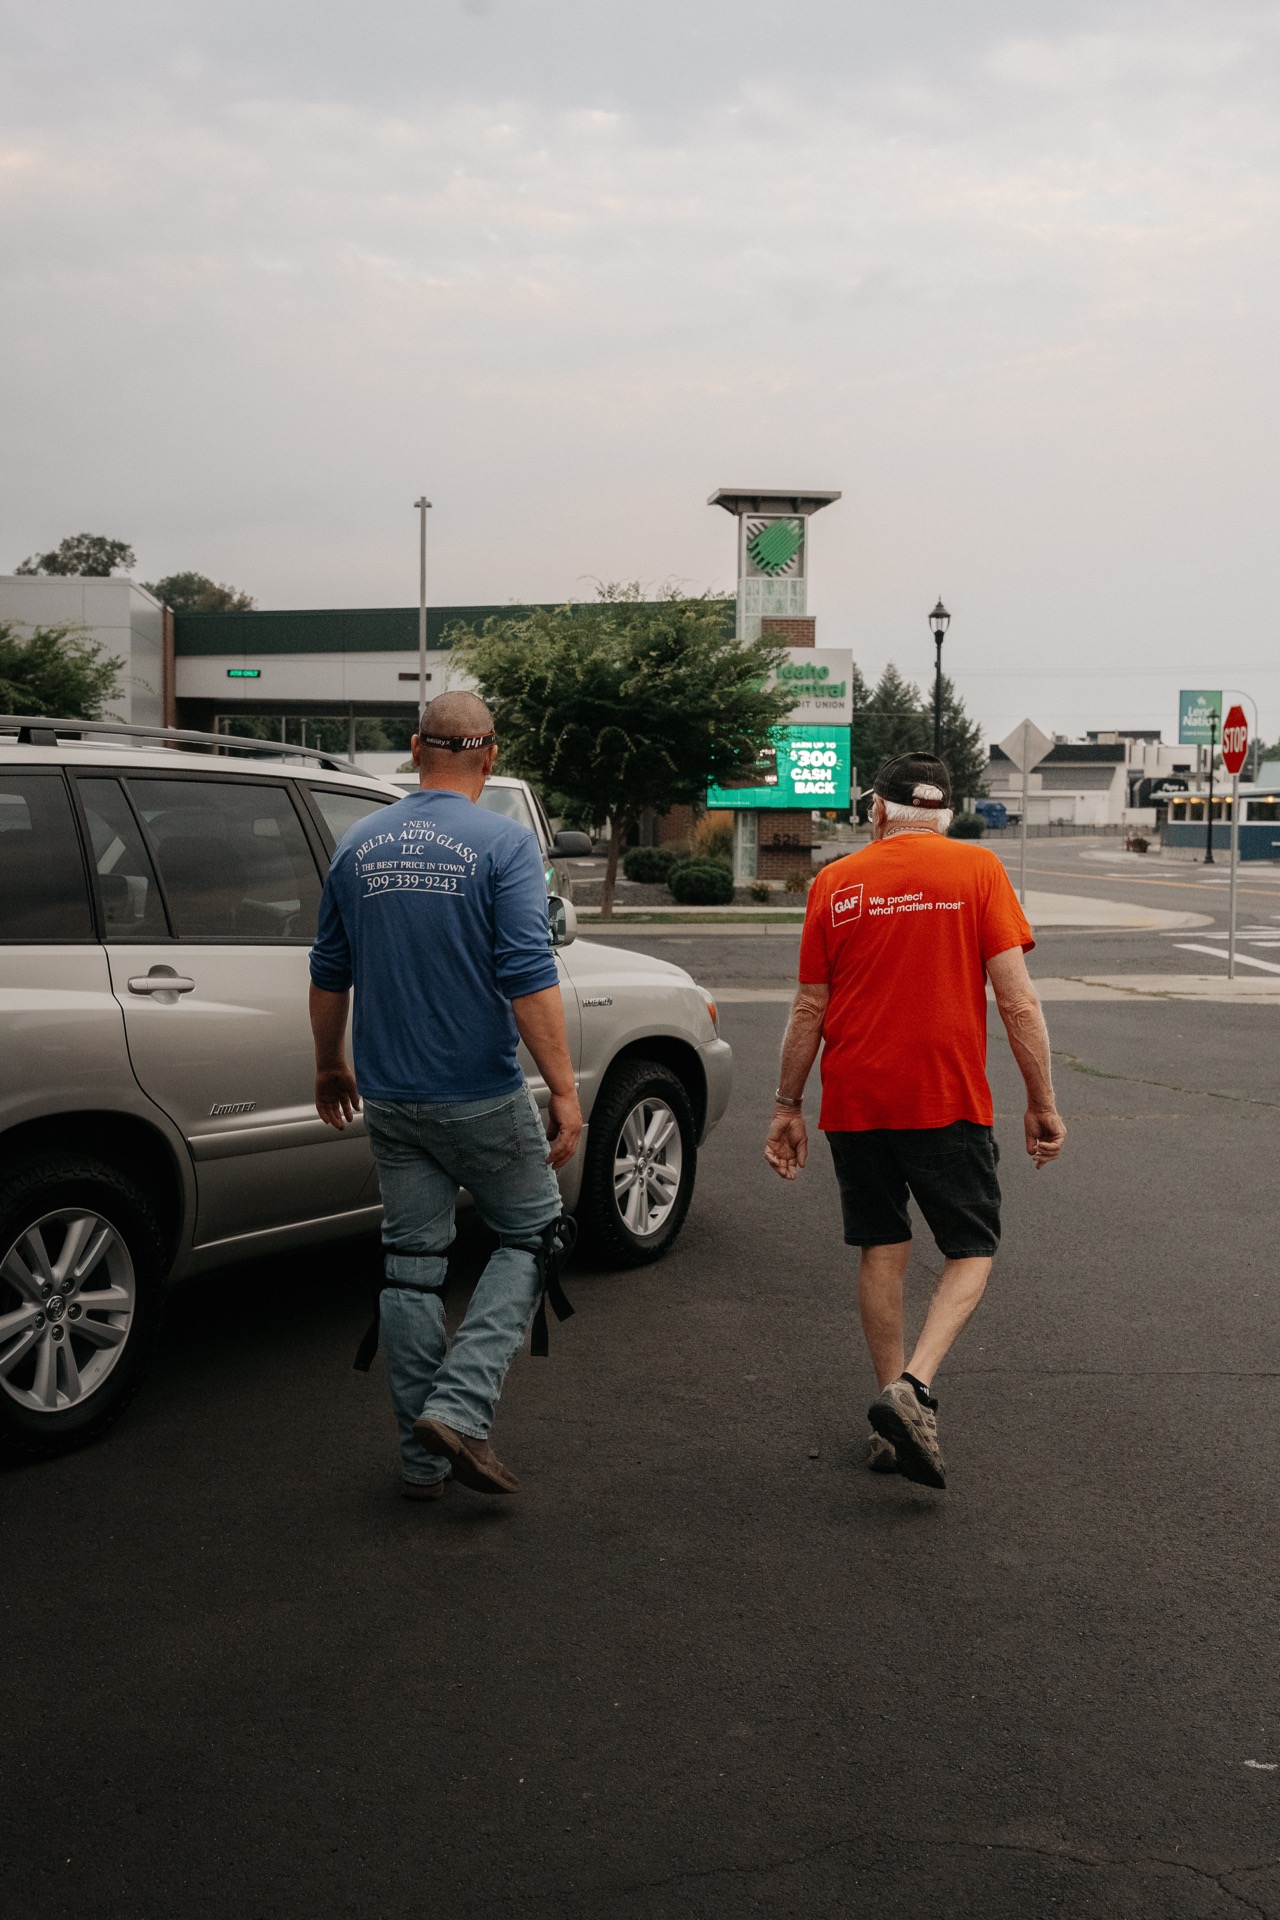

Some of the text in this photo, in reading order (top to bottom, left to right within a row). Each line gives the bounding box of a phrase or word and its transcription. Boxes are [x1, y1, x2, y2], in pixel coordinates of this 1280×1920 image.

[776, 680, 846, 698] entral
[815, 701, 845, 709] UNION
[1223, 726, 1247, 753] STOP
[790, 750, 837, 767] $300
[791, 768, 832, 781] CASH
[408, 821, 433, 829] NEW
[355, 829, 478, 863] DELTA AUTO GLASS
[401, 845, 424, 855] LLC
[362, 861, 465, 873] THE BEST PRICE IN TOWN
[367, 874, 457, 893] 509-339-9243
[834, 896, 858, 913] GAF
[869, 892, 923, 906] We protect
[868, 906, 894, 916] what
[896, 902, 933, 913] matters
